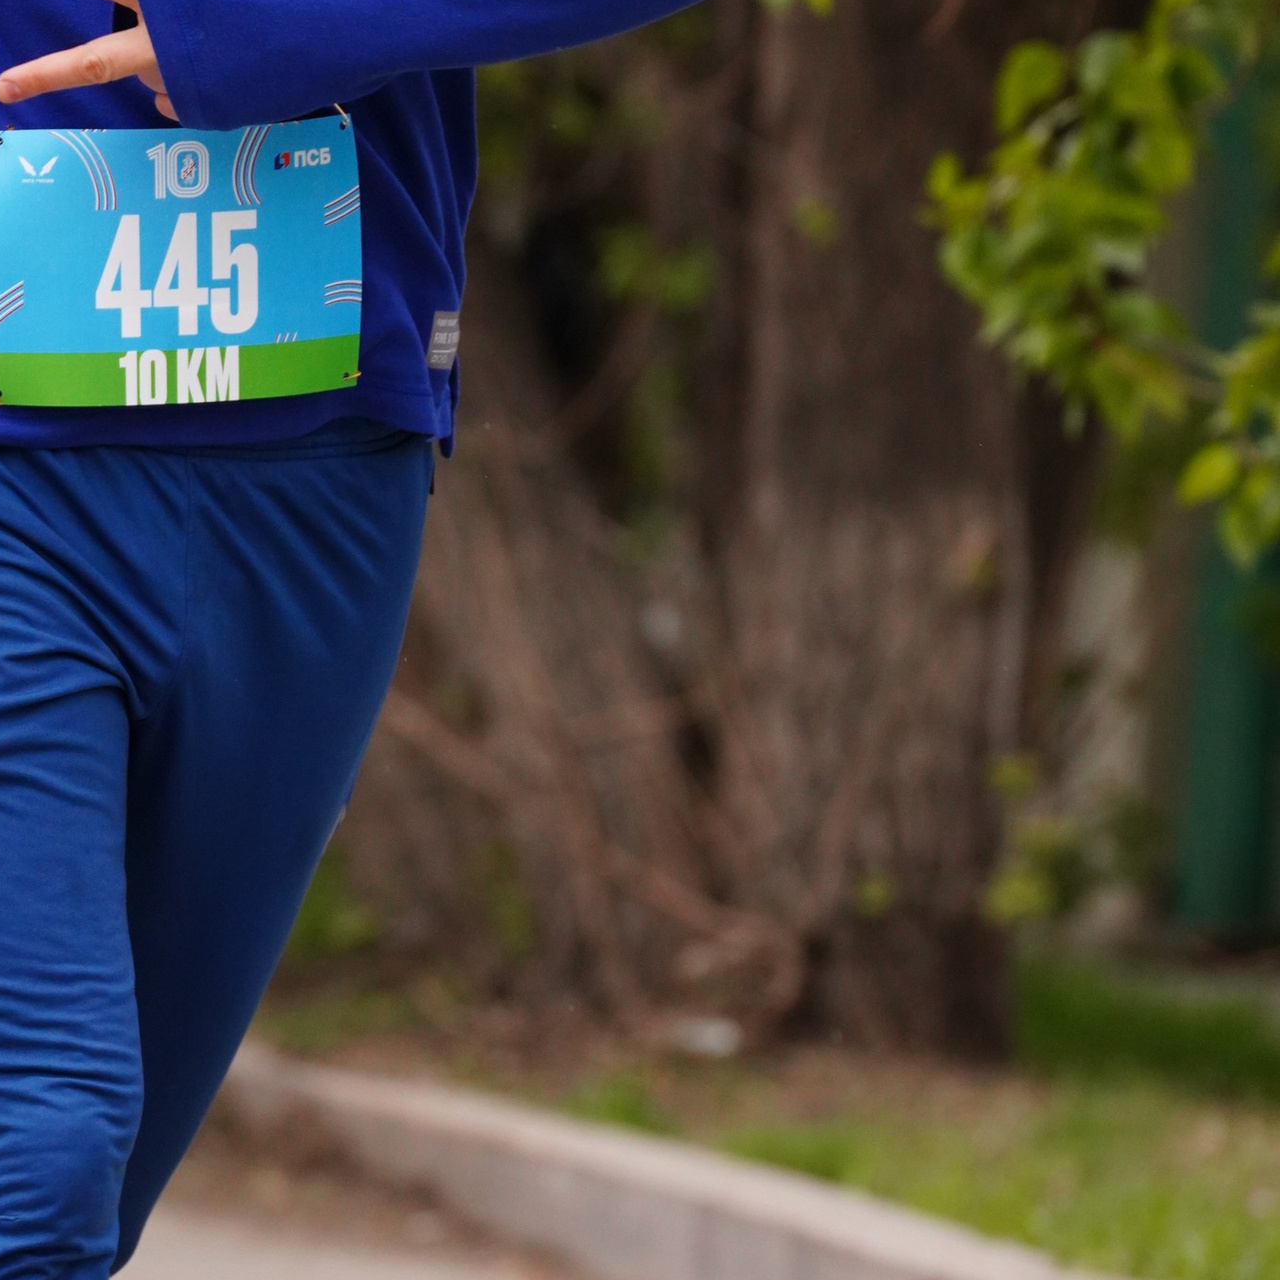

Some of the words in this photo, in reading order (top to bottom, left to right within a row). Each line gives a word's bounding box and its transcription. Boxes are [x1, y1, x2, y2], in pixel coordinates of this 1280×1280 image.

[146, 141, 209, 199] 10
[293, 147, 330, 168] ПСБ
[96, 210, 258, 338] 445
[119, 349, 167, 406] 10
[177, 345, 240, 404] KM
